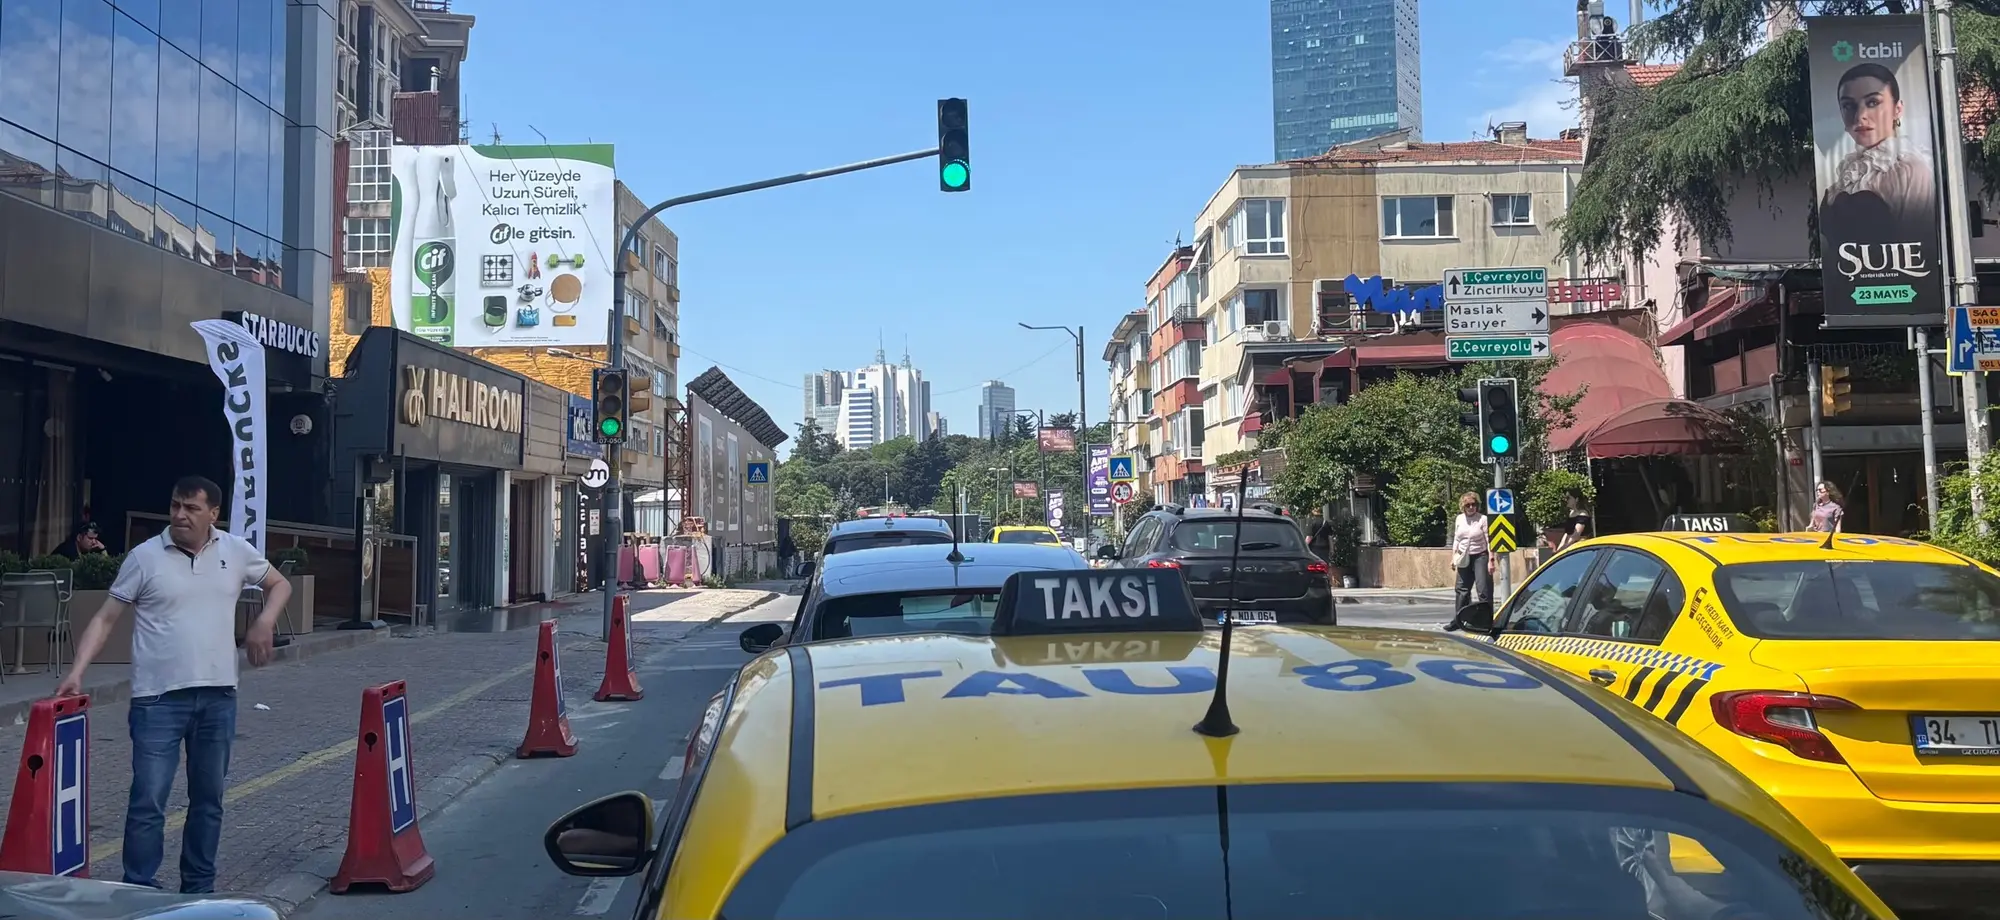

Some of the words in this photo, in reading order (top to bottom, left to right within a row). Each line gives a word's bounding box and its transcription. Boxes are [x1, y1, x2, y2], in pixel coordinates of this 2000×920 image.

[1858, 42, 1902, 58] tabii
[489, 169, 515, 182] Her
[520, 169, 581, 185] Yüzeyde
[492, 186, 529, 198] Uzun
[534, 186, 578, 199] Süreli,
[482, 203, 519, 215] Kalıcı
[529, 226, 575, 243] gitsin.
[1837, 242, 1931, 282] ŞULE
[1464, 272, 1542, 283] 1.Çevreyolu
[1464, 285, 1543, 296] Zincirlikuyu
[1859, 291, 1872, 300] 23
[1874, 289, 1909, 299] MAYIS
[1450, 304, 1503, 315] Maslak
[1451, 319, 1506, 330] Sarıyer
[241, 310, 319, 358] STARBUCKS
[1451, 341, 1531, 354] 2.Çevreyolu
[431, 368, 522, 434] HALIROOM
[1115, 487, 1122, 497] 4
[1257, 611, 1274, 621] 064
[818, 666, 1217, 707] TAU
[1292, 659, 1544, 692] 86
[1928, 720, 1956, 744] 34
[386, 717, 410, 812] H
[57, 739, 81, 853] H
